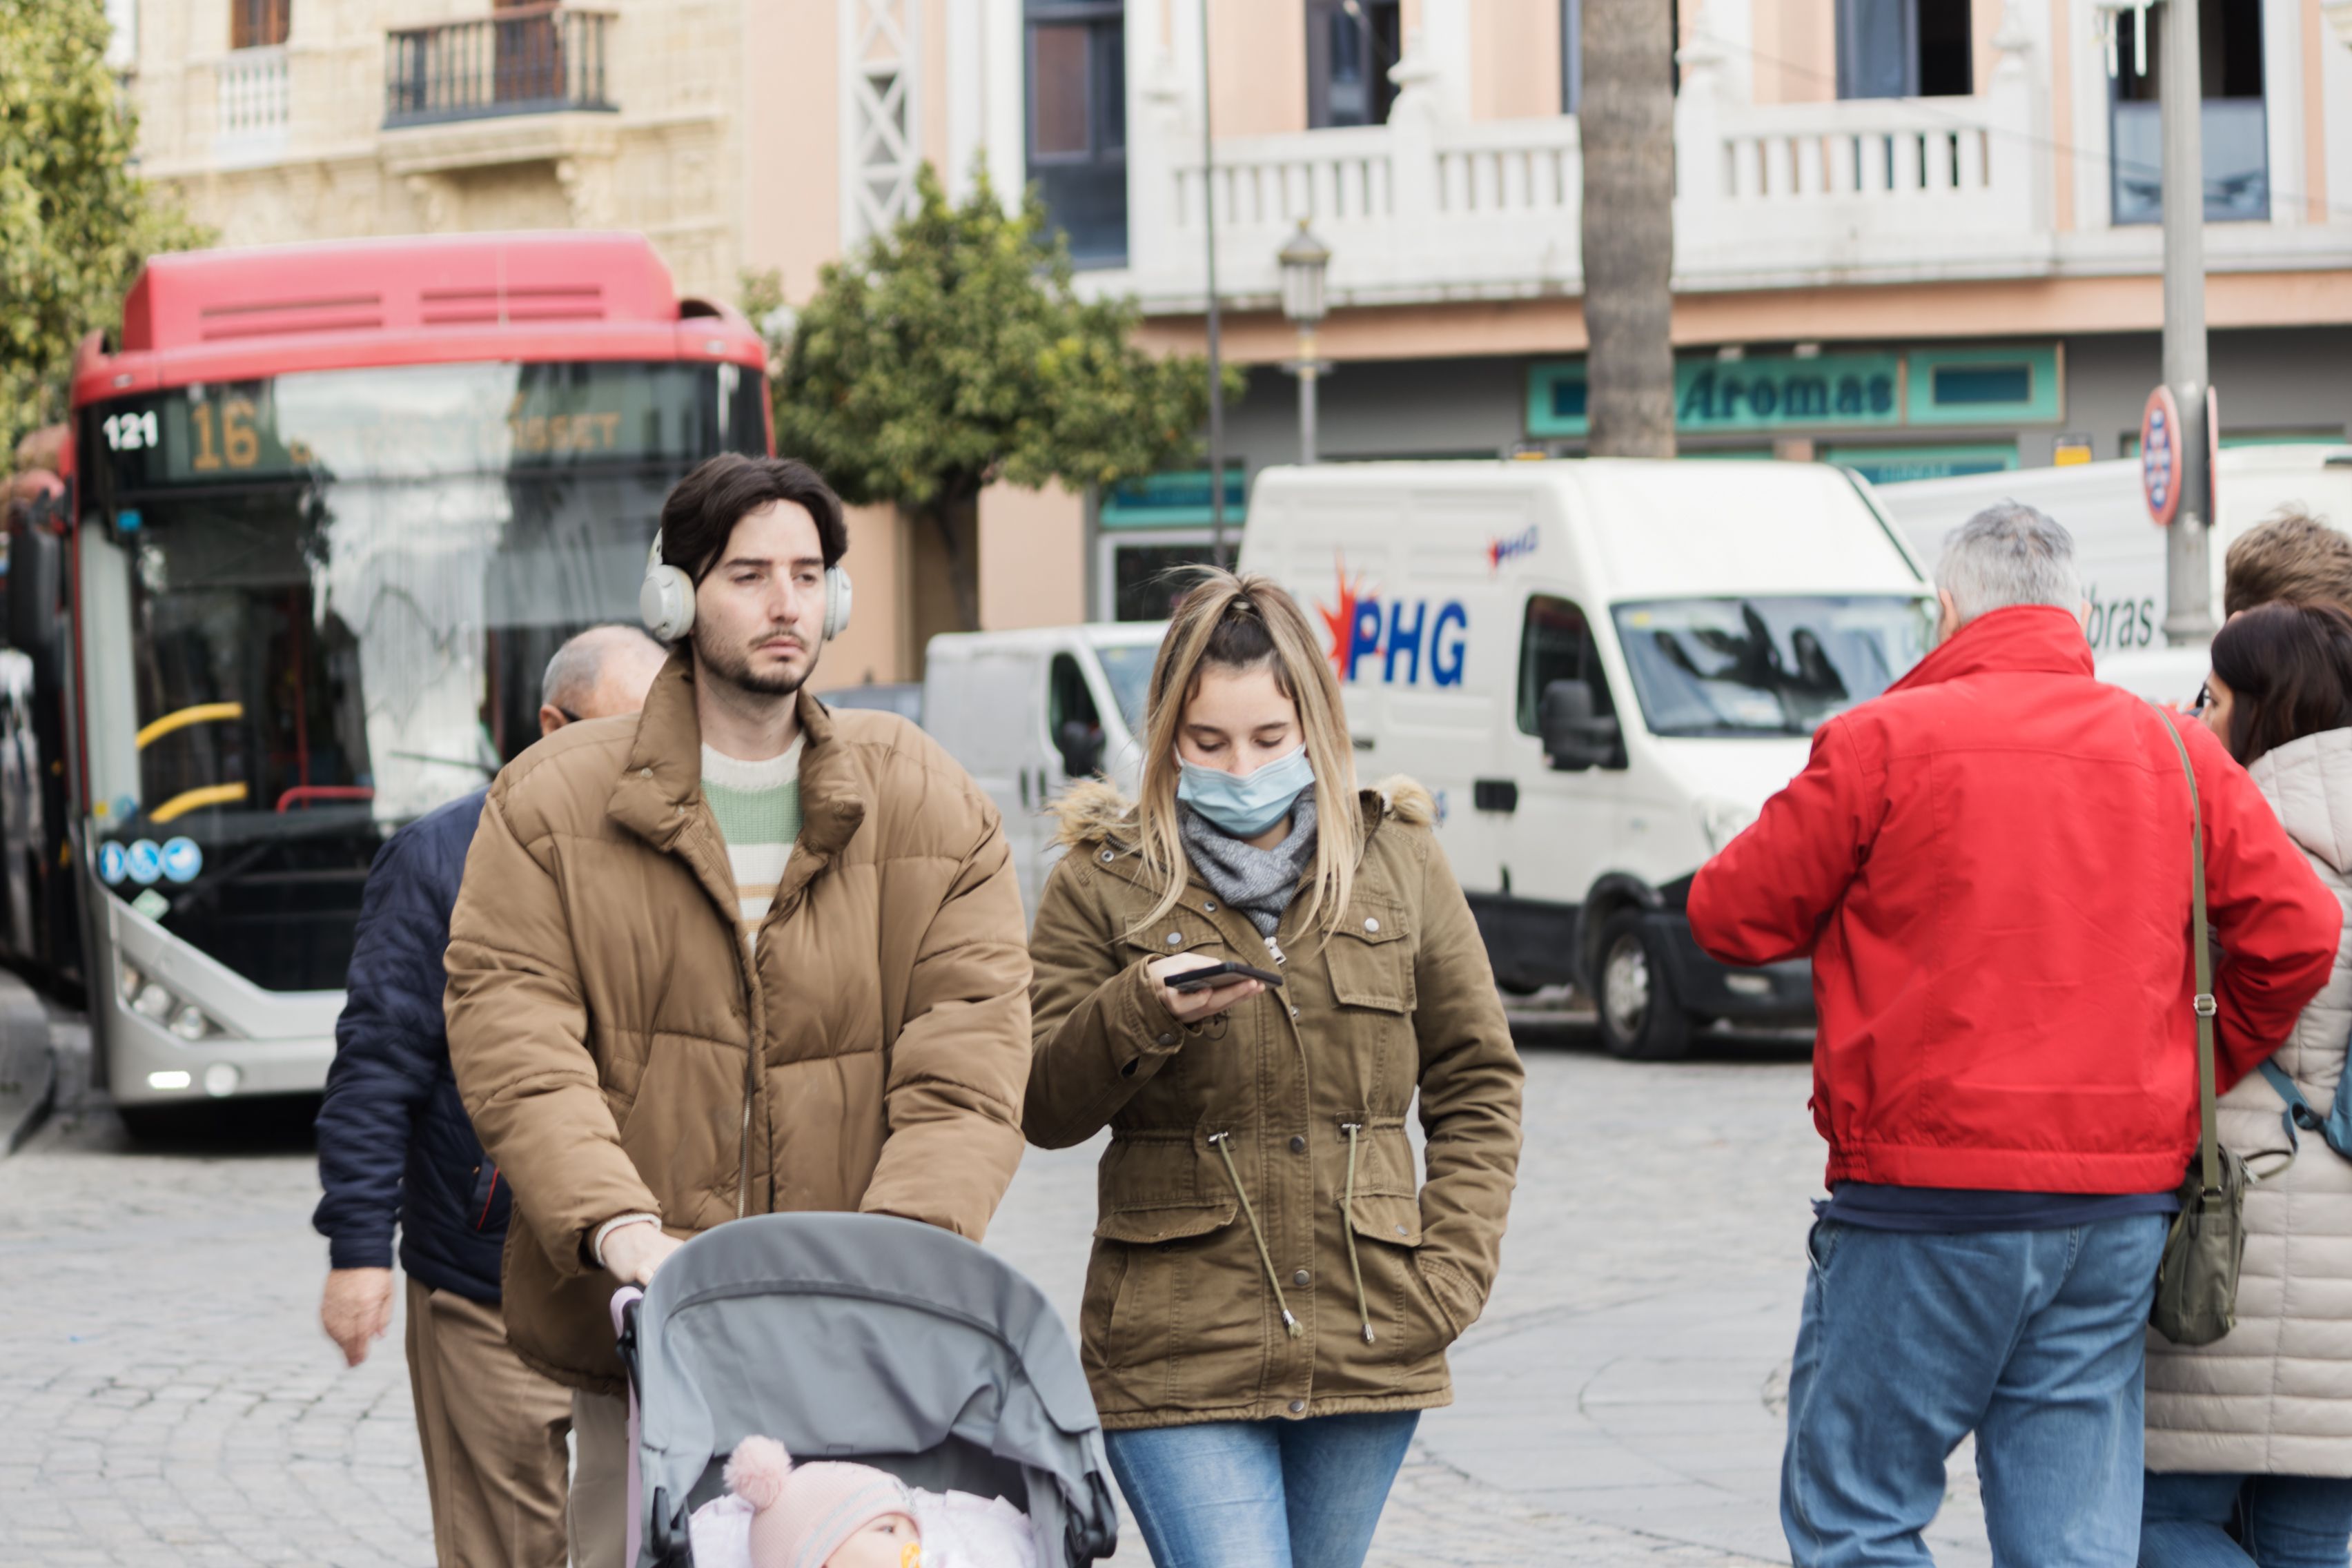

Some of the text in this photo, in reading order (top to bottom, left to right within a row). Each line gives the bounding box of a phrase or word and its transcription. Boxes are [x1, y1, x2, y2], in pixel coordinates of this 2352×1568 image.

[1678, 368, 1892, 419] Aromas
[102, 410, 159, 451] 121
[191, 399, 259, 472] 16
[1348, 599, 1467, 687] PHG
[2080, 582, 2154, 649] bras
